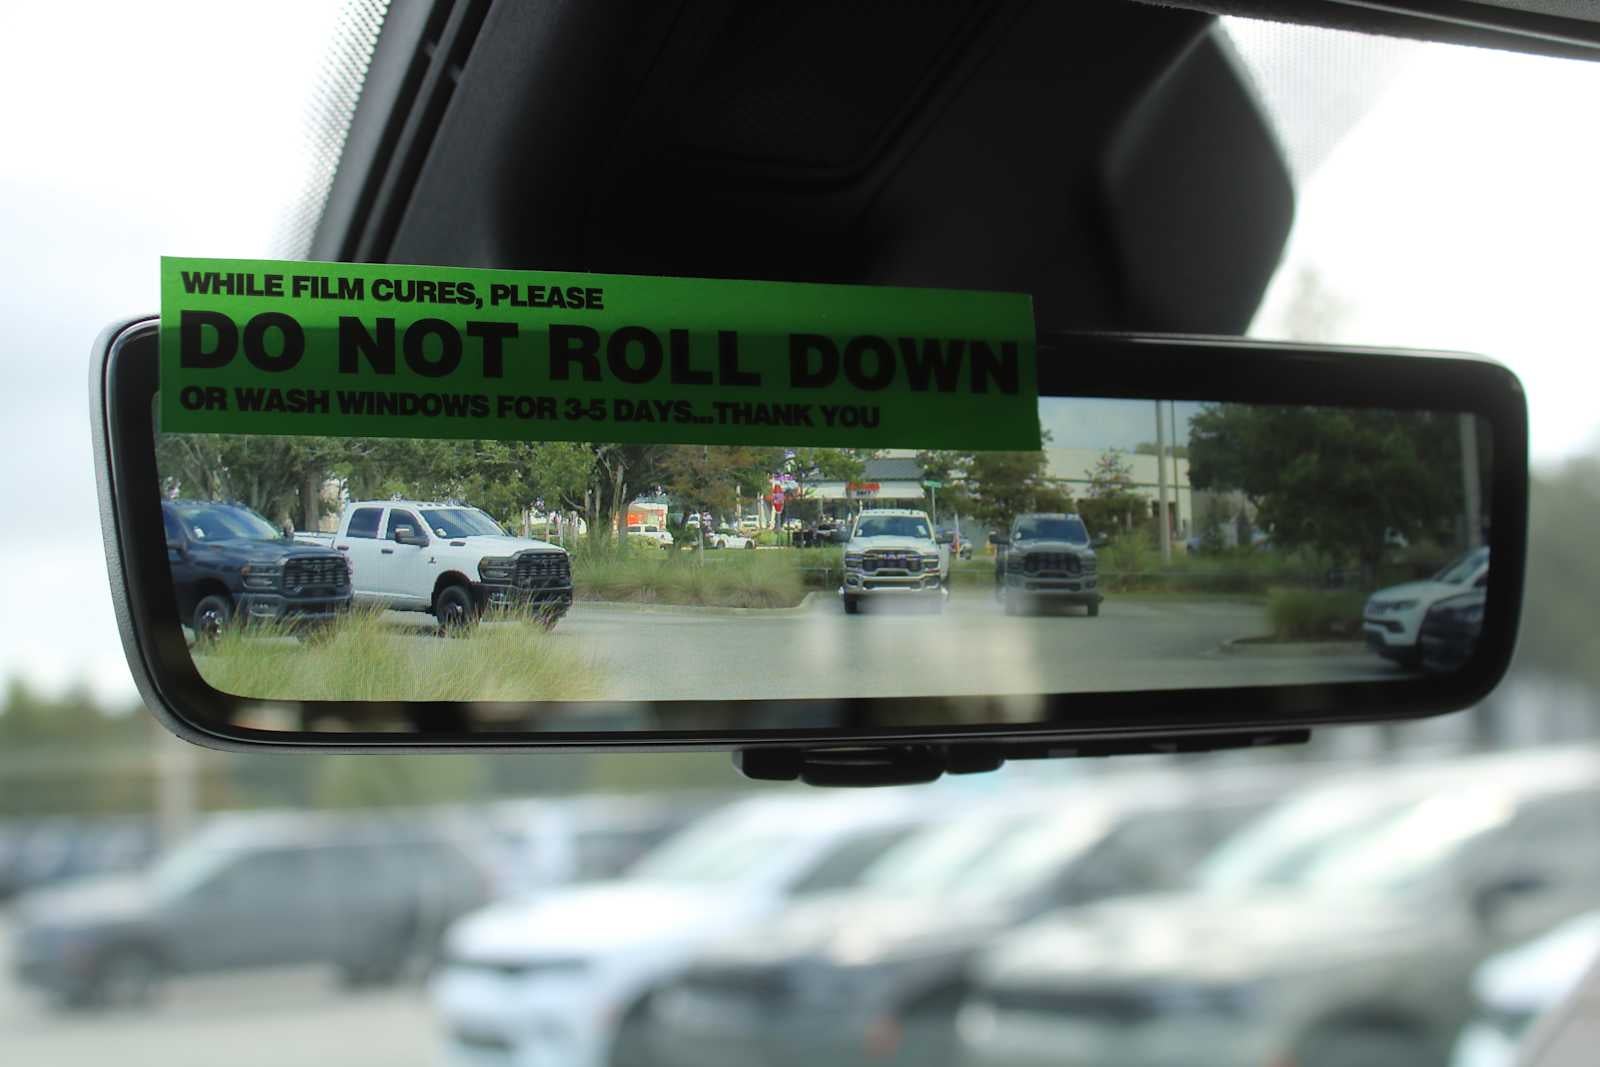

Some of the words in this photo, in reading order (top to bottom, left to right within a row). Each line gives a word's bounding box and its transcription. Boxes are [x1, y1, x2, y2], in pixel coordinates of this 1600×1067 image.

[181, 272, 284, 297] WHILE
[292, 275, 365, 301] FILM
[371, 278, 483, 309] CURES,
[490, 284, 604, 310] PLEASE
[180, 310, 305, 373] DO
[338, 315, 519, 378] NOT
[548, 324, 762, 387] ROLL
[788, 333, 1020, 395] DOWN
[180, 385, 228, 412] OR
[235, 387, 330, 414] WASH
[337, 391, 490, 418] WINDOWS
[497, 396, 559, 420] FOR
[563, 400, 607, 422] 3-5
[823, 405, 881, 429] YOU
